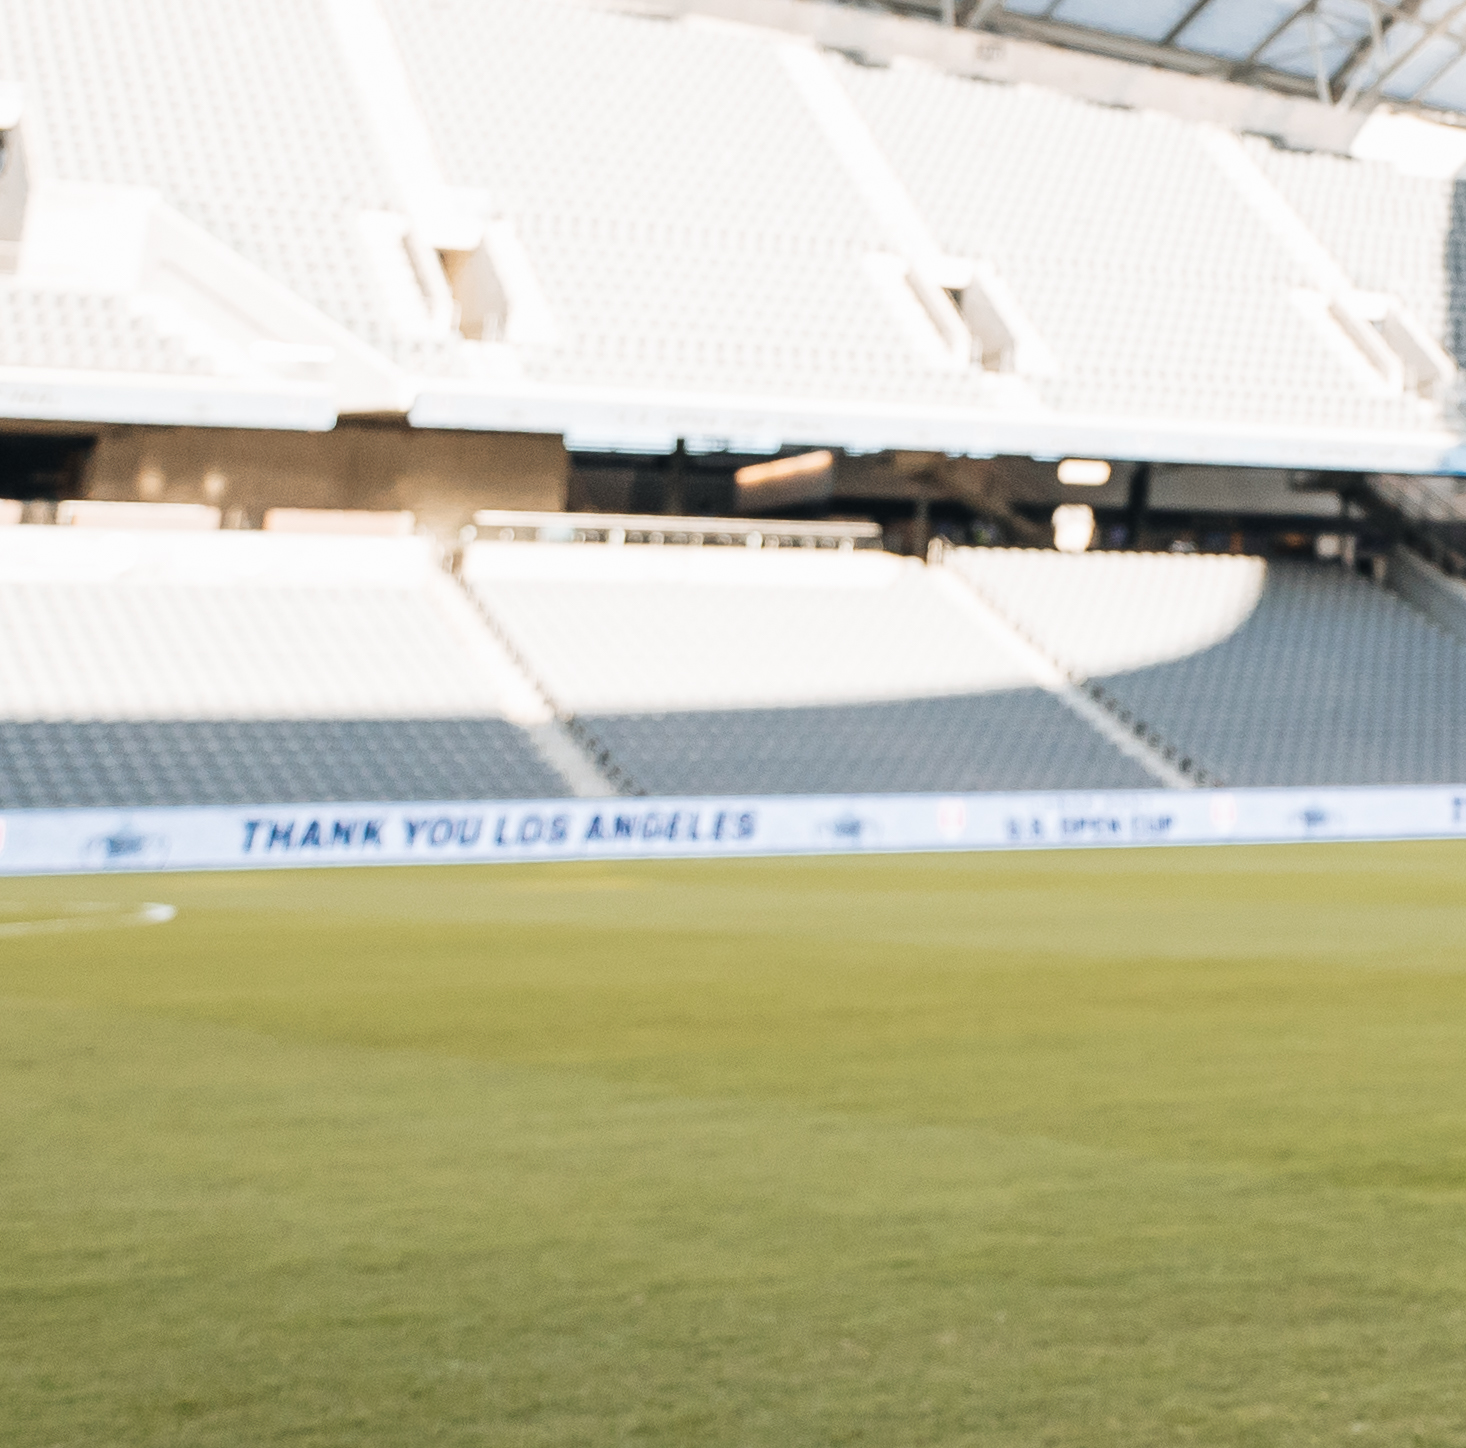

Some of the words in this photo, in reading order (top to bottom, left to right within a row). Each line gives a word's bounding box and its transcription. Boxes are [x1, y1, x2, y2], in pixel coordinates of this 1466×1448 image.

[241, 817, 385, 852] THANK
[403, 814, 484, 848] YOU
[495, 813, 569, 846] LOS
[584, 809, 758, 844] ANGELES
